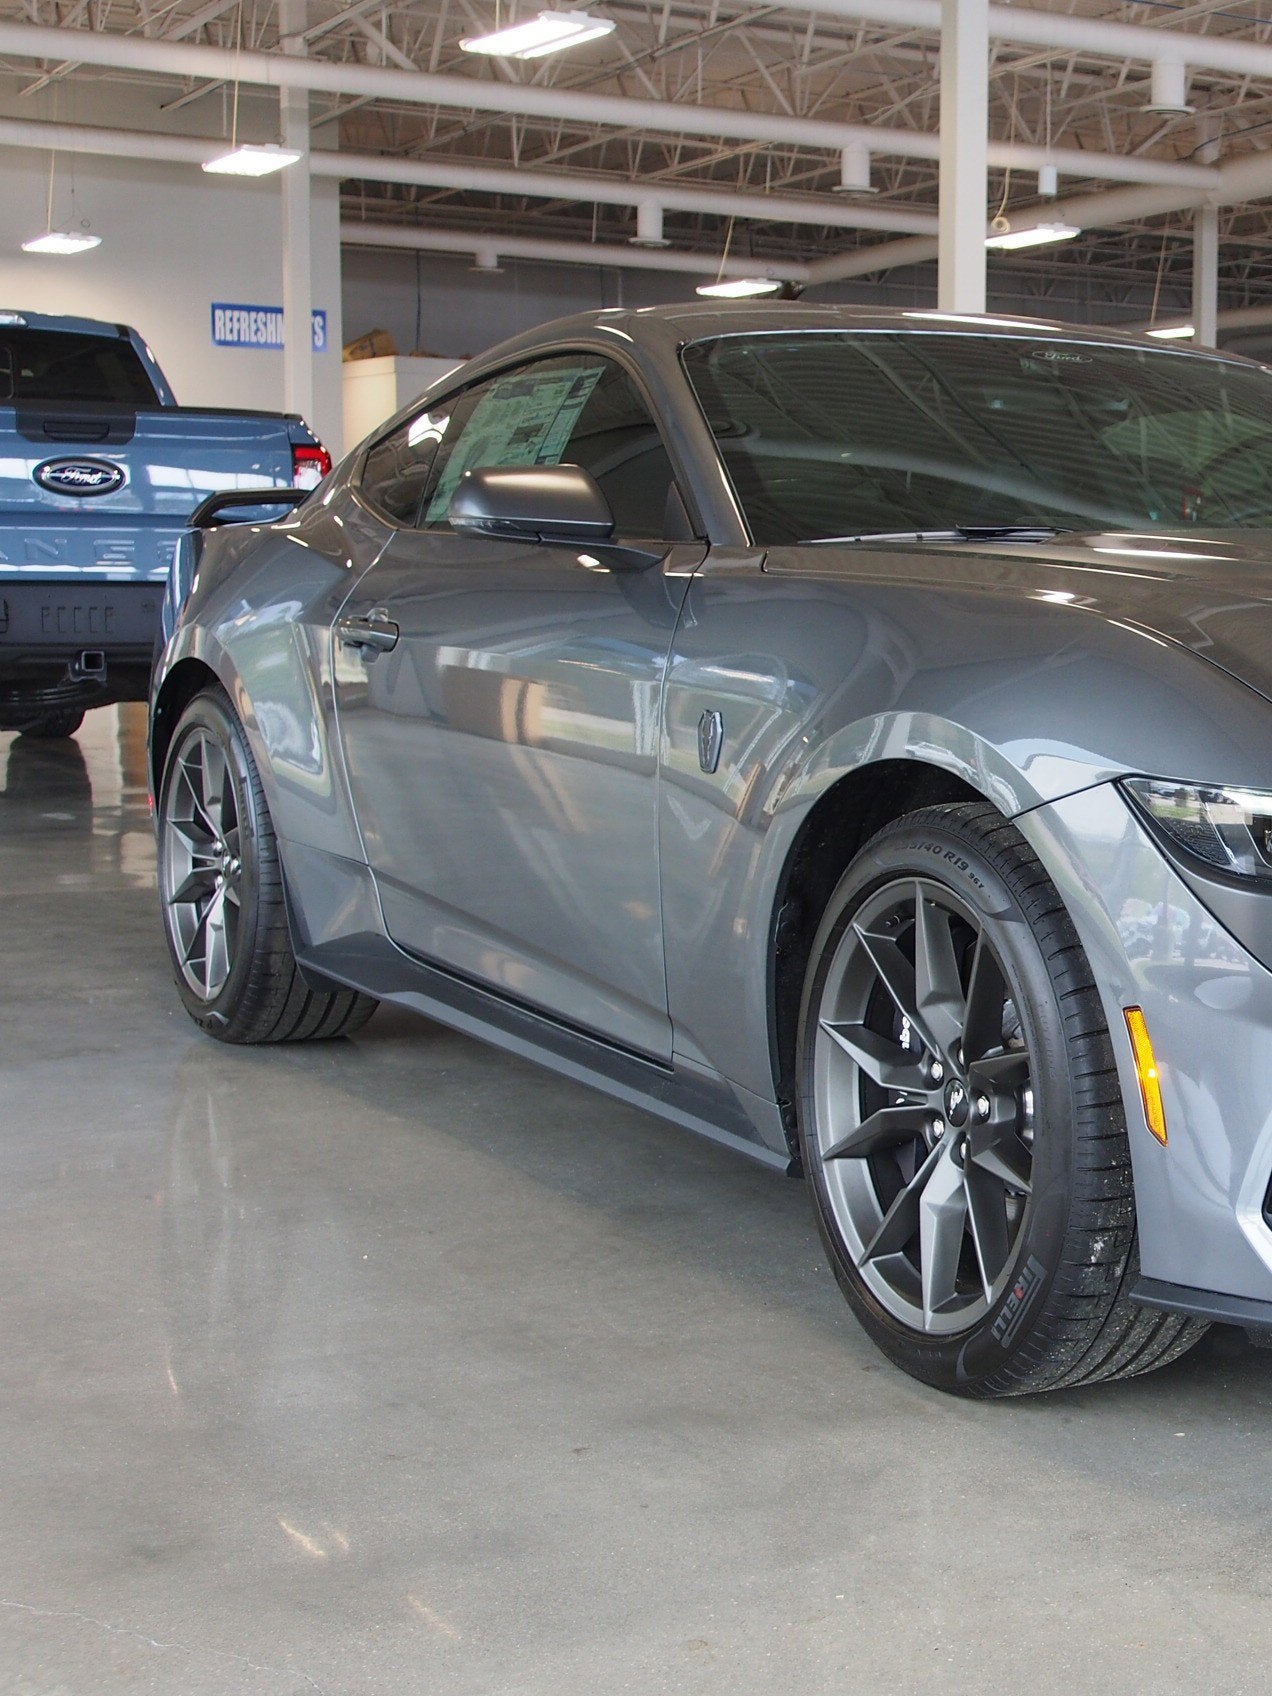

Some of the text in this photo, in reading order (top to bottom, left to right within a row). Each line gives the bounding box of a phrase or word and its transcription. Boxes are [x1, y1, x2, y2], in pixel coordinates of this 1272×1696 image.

[215, 308, 324, 347] REFRESHS
[61, 467, 102, 485] Ford
[943, 851, 970, 871] R19
[991, 1254, 1048, 1349] PIRELLI
